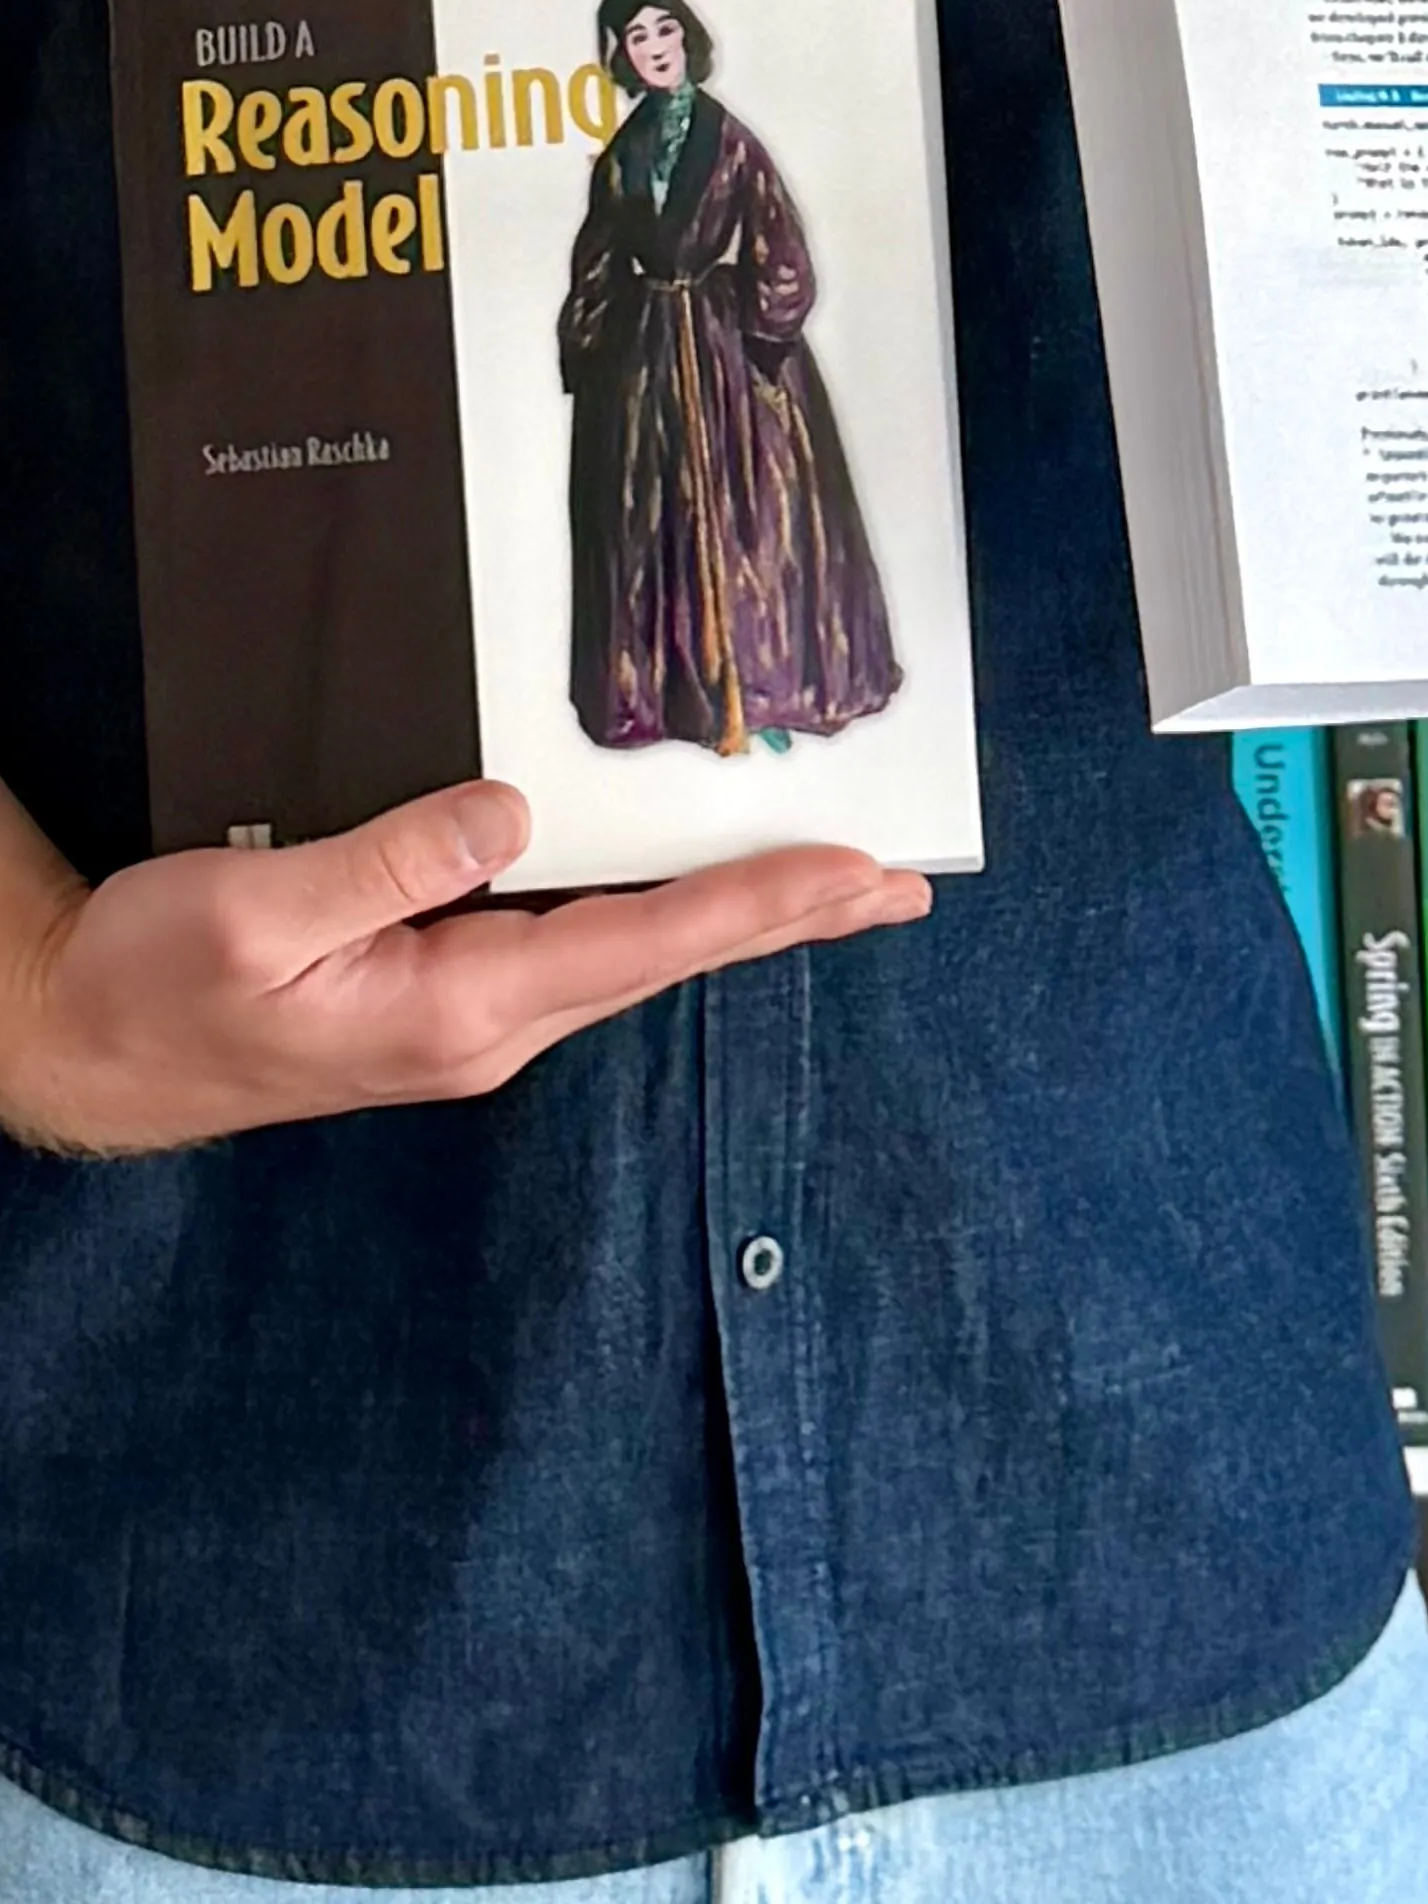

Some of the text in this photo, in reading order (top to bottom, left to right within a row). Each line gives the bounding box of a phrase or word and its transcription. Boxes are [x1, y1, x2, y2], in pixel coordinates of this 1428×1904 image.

[196, 24, 316, 67] BUILD A
[183, 54, 617, 176] Reasoning
[189, 174, 447, 292] Model
[203, 433, 391, 475] Sebastian Raschka
[1358, 931, 1412, 1033] Spring
[1373, 1061, 1410, 1146] ACTION
[1374, 1153, 1413, 1212] Sixth
[1377, 1216, 1416, 1296] Edition
